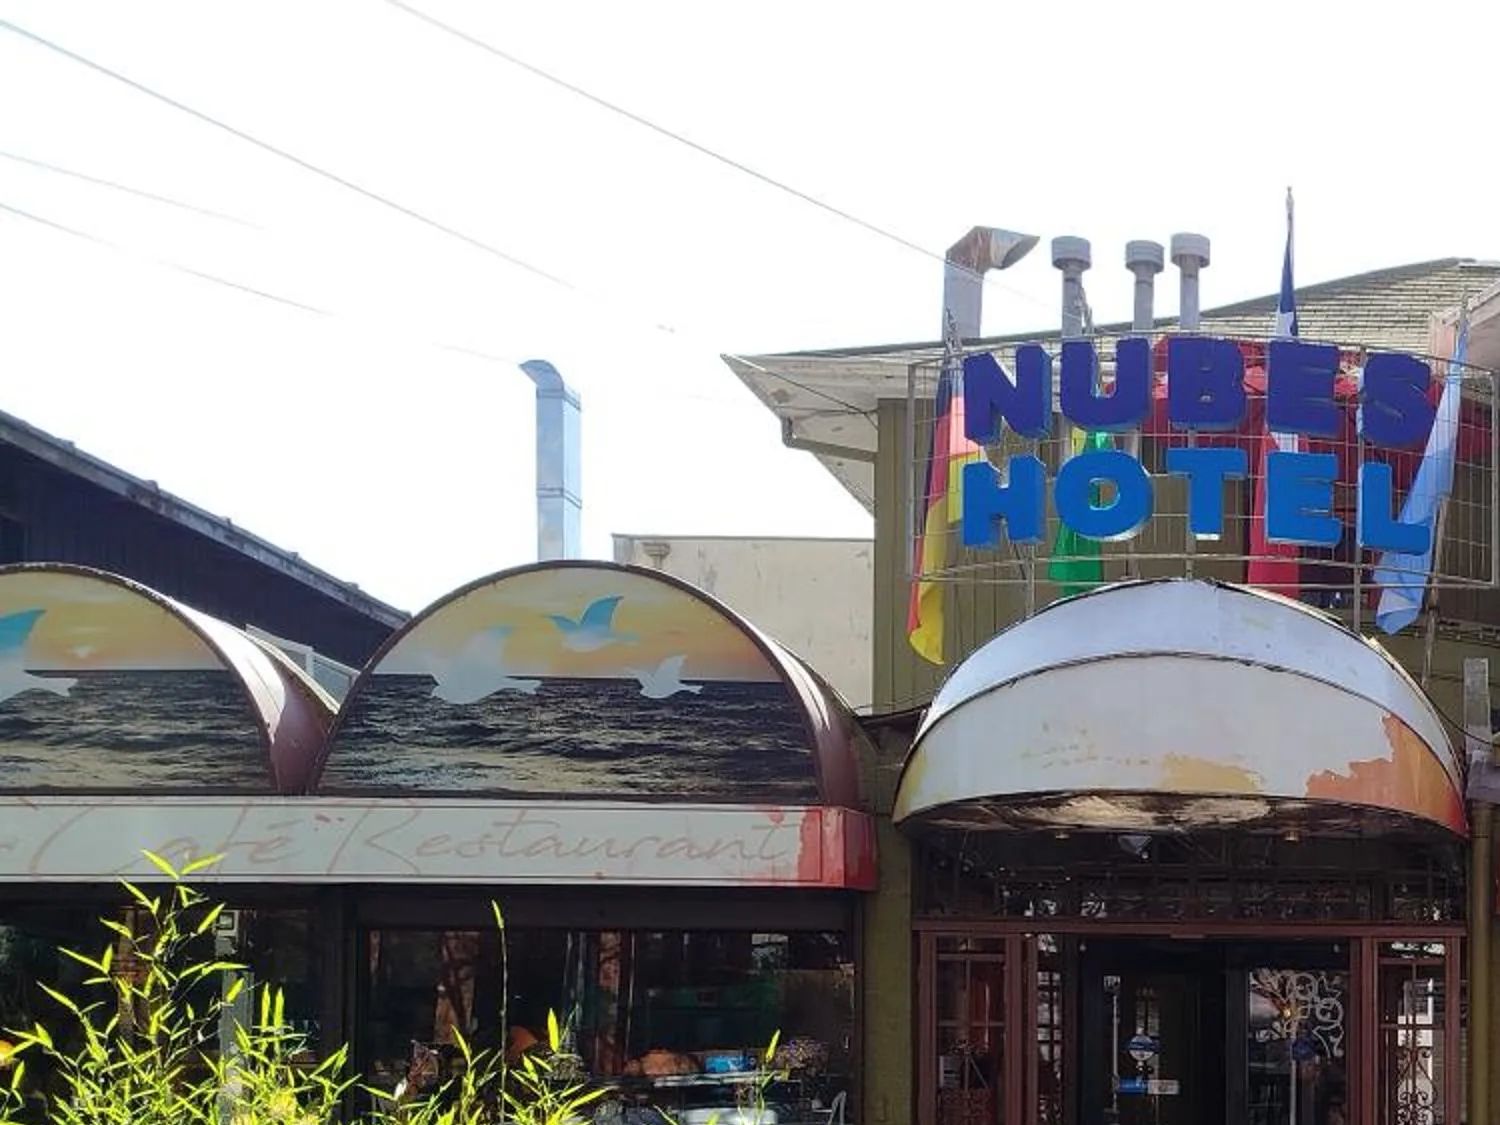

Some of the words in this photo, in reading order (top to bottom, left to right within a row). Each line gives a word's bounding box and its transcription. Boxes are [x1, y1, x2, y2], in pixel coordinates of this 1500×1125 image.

[963, 338, 1431, 447] NUBES
[963, 447, 1431, 555] HOTEL
[327, 800, 801, 877] Restaurant
